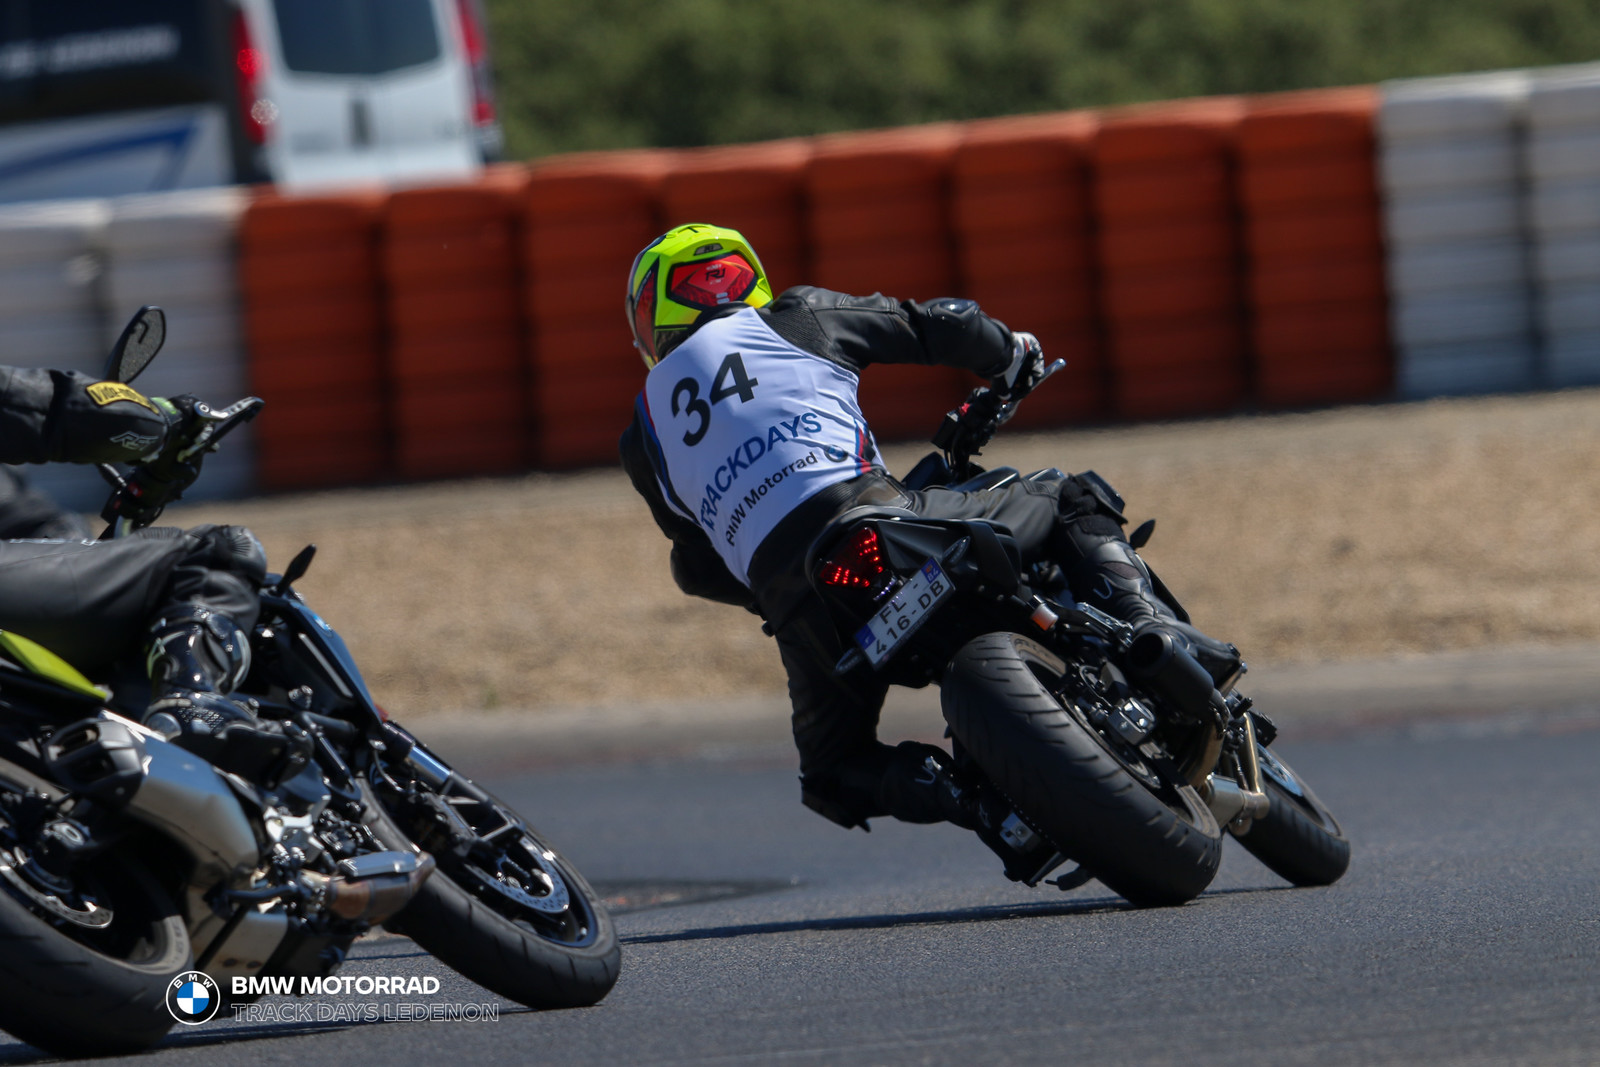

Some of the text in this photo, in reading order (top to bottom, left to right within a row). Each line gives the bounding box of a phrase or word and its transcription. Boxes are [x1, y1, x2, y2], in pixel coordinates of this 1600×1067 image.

[671, 351, 758, 447] 34
[701, 412, 822, 532] TRACKDAYS
[743, 451, 819, 510] Motorrad
